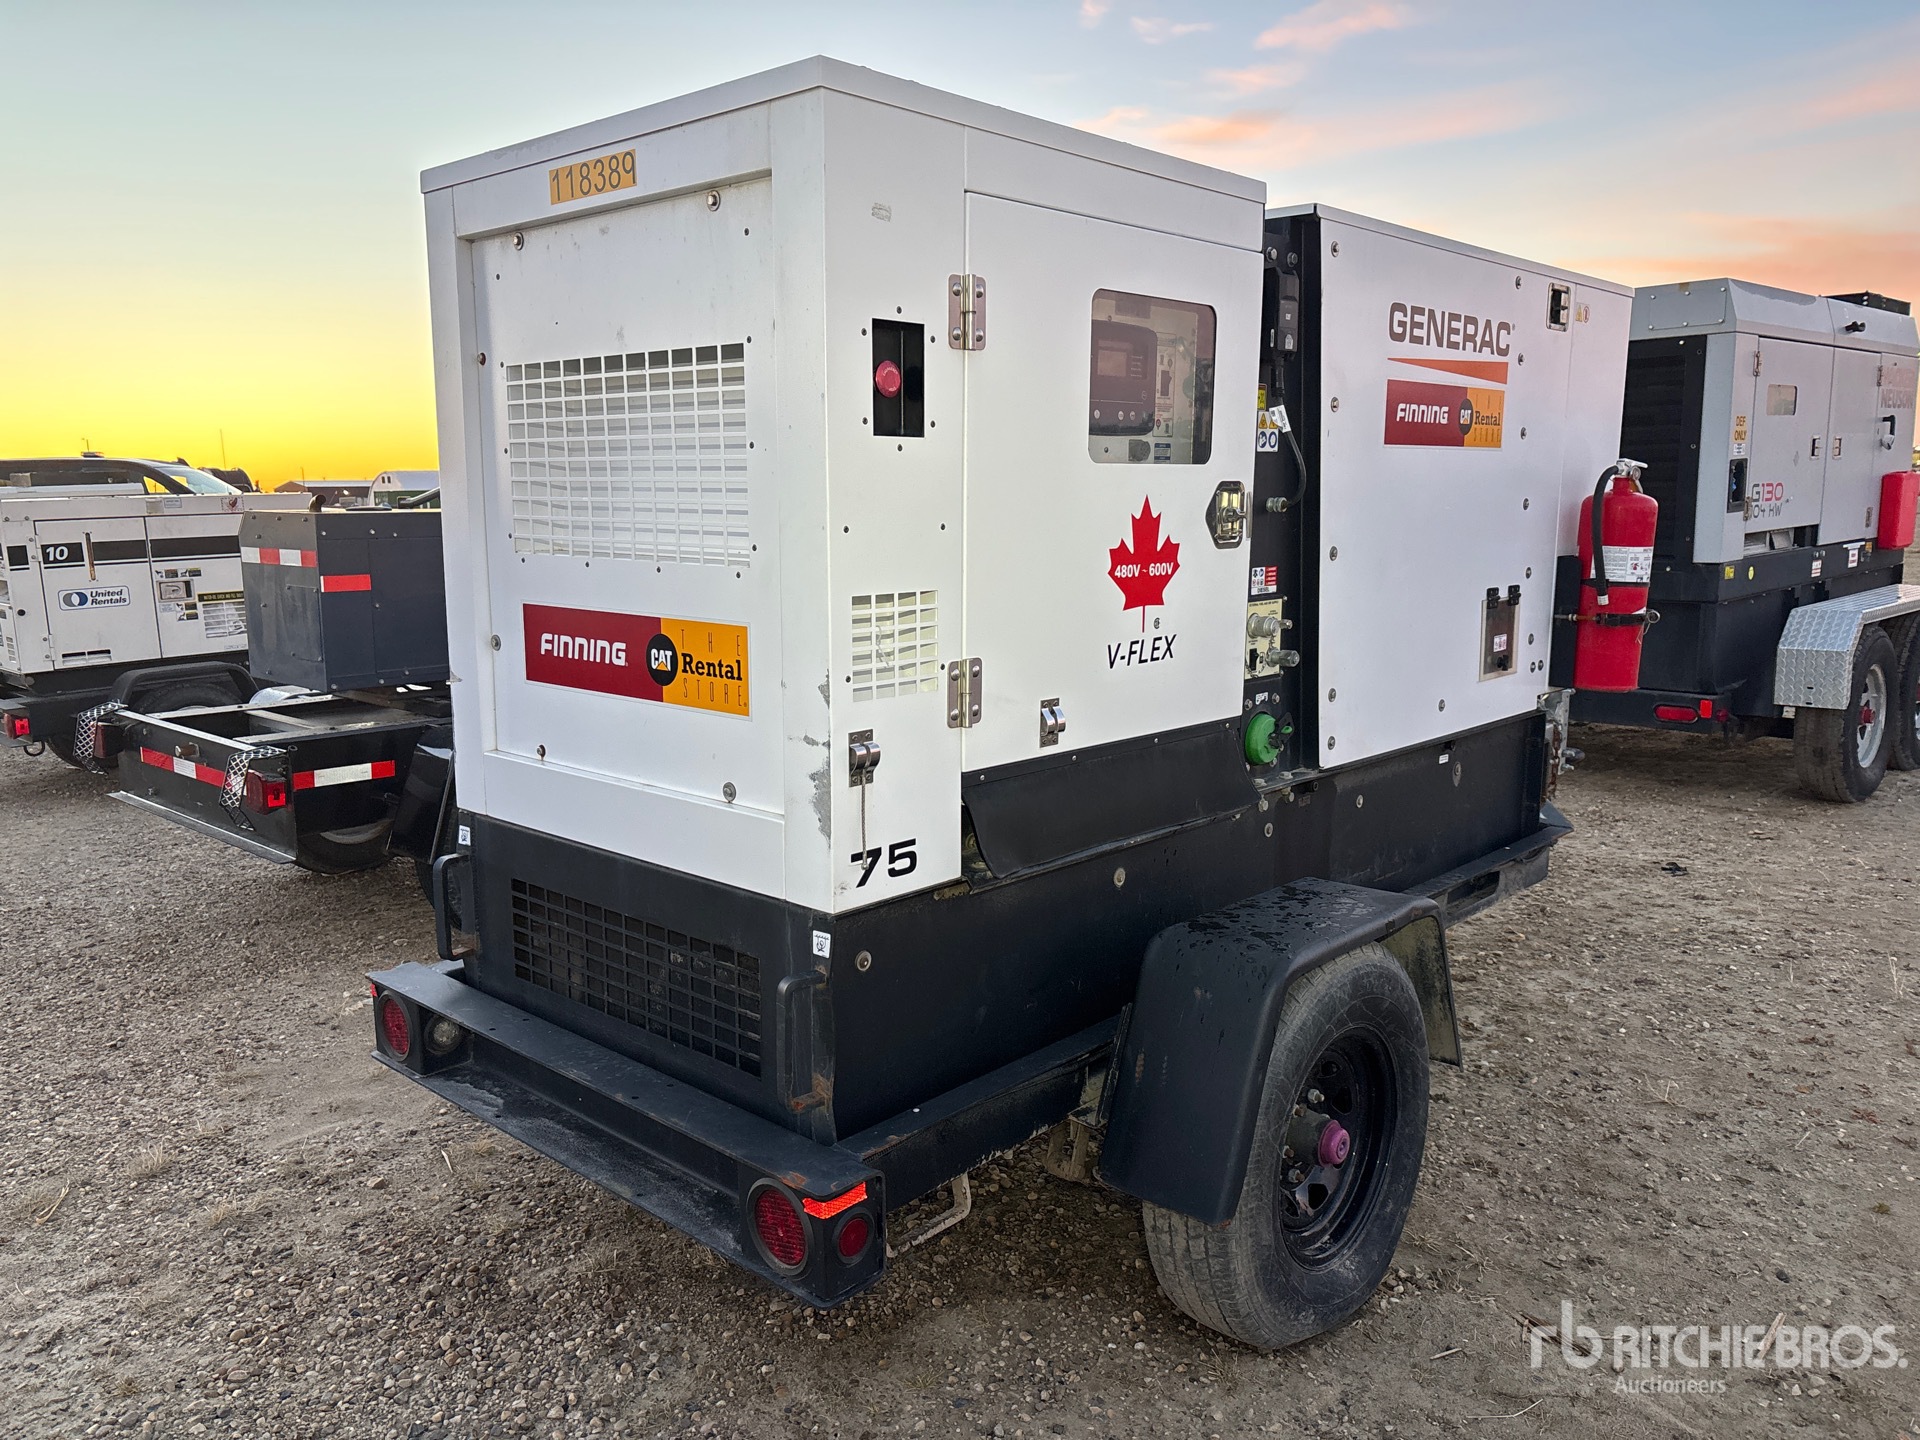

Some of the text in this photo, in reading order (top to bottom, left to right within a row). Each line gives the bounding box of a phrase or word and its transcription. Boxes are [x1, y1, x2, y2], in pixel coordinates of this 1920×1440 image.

[552, 151, 636, 202] 118389
[1388, 301, 1511, 357] GENERAC
[1396, 403, 1449, 425] FINNING
[1460, 409, 1472, 425] CAT
[1474, 411, 1501, 427] Rental
[1735, 415, 1747, 427] DEF
[1734, 430, 1747, 441] ONLY
[1752, 482, 1784, 502] G130
[45, 545, 69, 561] 10
[1114, 563, 1141, 579] 480V
[1148, 561, 1174, 577] 600V
[90, 589, 123, 599] United
[90, 596, 127, 606] Rentals
[540, 632, 627, 667] FINNING
[650, 648, 673, 672] CAT
[1107, 633, 1177, 670] V-FLEX
[681, 652, 743, 682] Rental
[683, 678, 742, 707] STORE
[850, 837, 918, 889] 75
